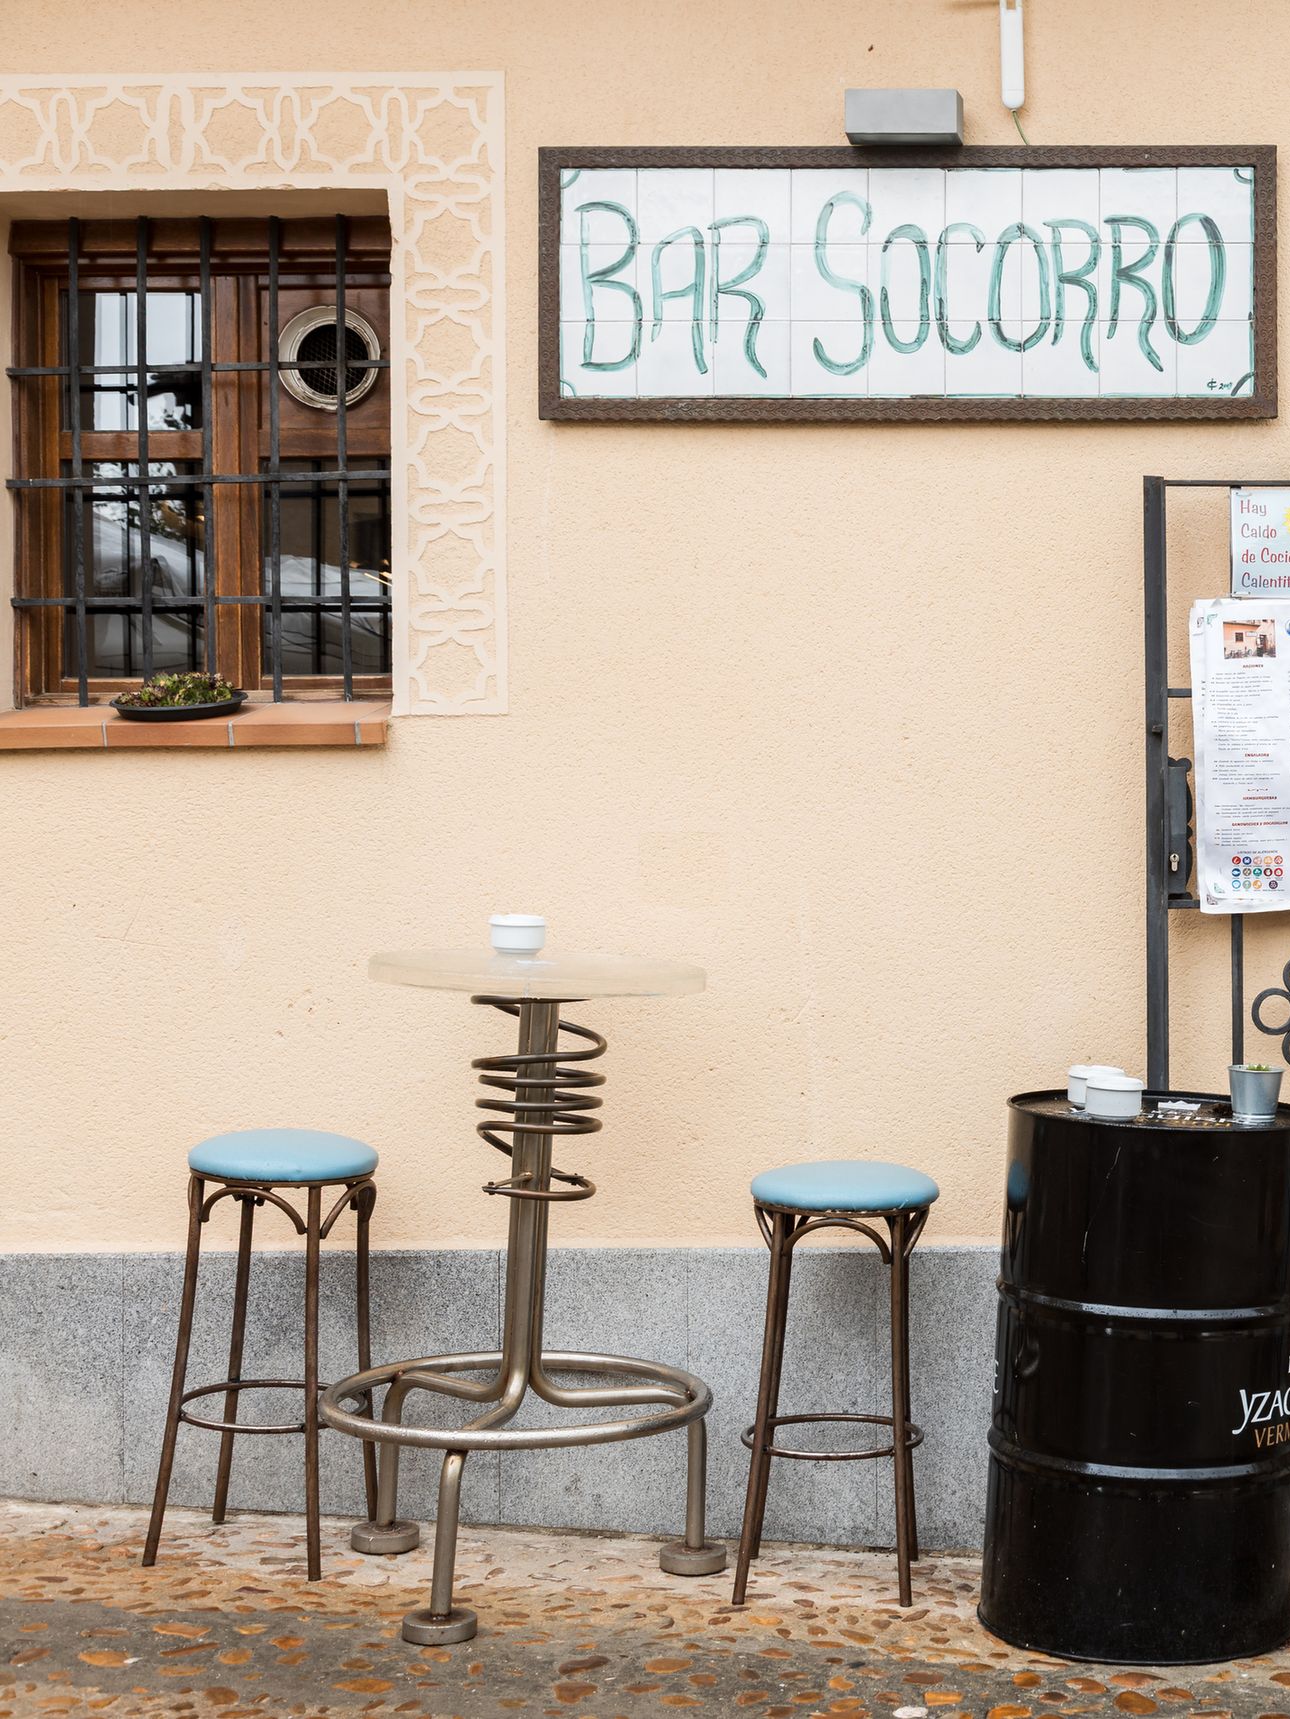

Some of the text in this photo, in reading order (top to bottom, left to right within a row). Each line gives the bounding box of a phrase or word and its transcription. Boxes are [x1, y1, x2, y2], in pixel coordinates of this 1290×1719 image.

[573, 189, 1228, 379] BAR SOCORRO
[1239, 499, 1267, 517] Hay
[1240, 523, 1277, 539] Caldo
[1241, 549, 1256, 564] de
